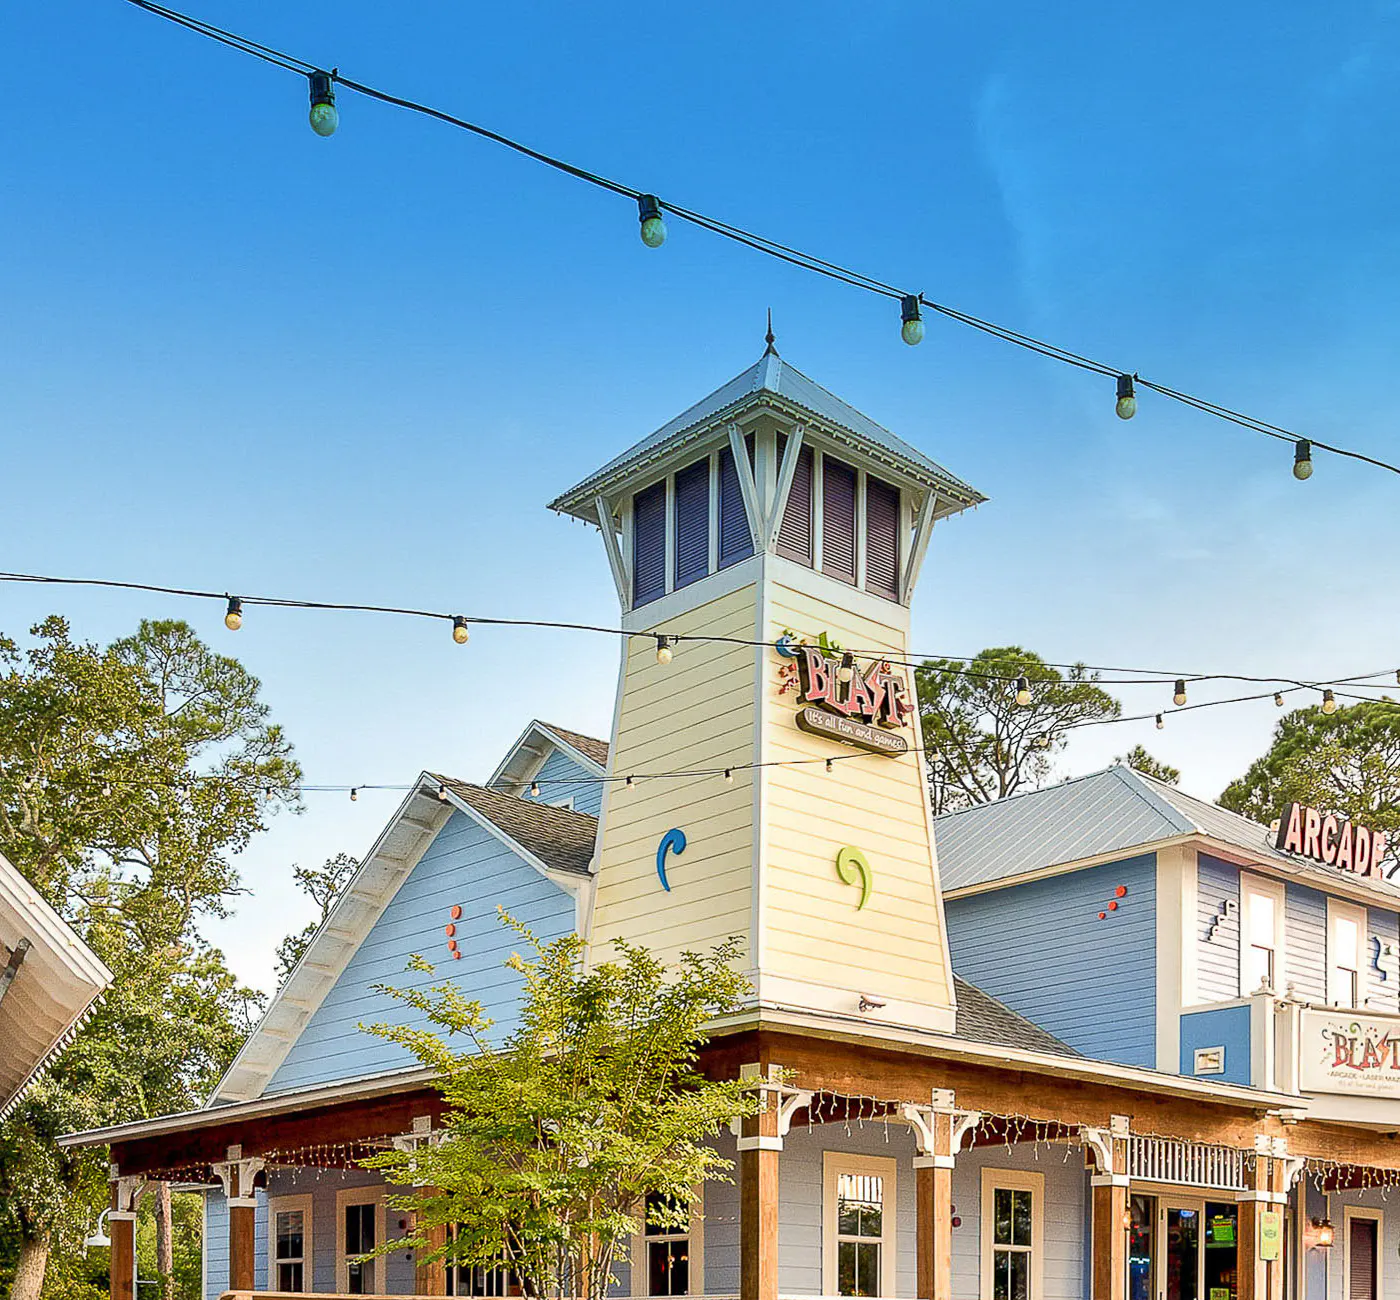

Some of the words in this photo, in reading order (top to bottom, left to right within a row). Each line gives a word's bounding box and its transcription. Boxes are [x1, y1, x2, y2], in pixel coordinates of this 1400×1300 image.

[803, 648, 905, 728] BLAST
[808, 711, 823, 725] It's
[825, 716, 836, 729] all
[838, 720, 854, 734] fun
[855, 729, 873, 741] and
[1282, 801, 1386, 880] ARCADE
[1332, 1030, 1400, 1071] BLAST
